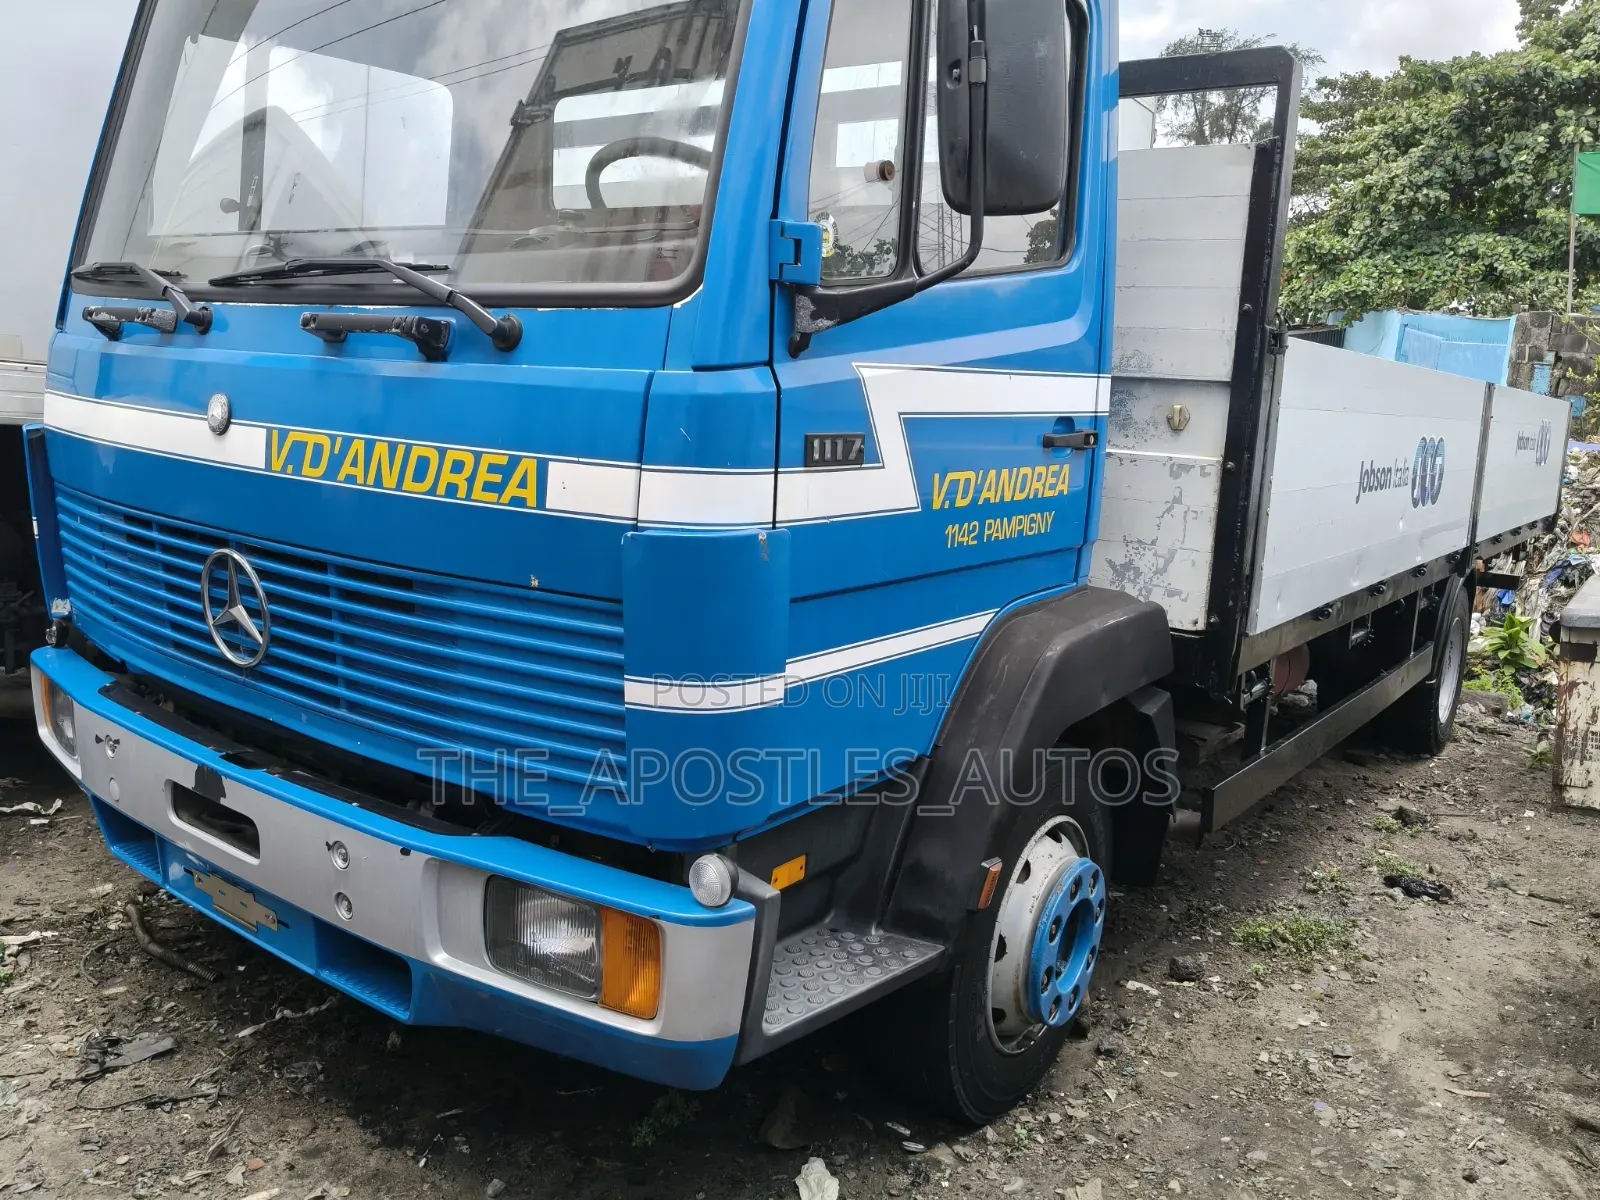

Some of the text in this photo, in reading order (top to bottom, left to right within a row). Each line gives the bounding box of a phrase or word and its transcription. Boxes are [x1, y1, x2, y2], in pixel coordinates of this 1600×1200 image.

[812, 437, 863, 462] 1117
[1355, 459, 1392, 504] Jobson
[945, 511, 1055, 549] 1142 PAMPIGNY
